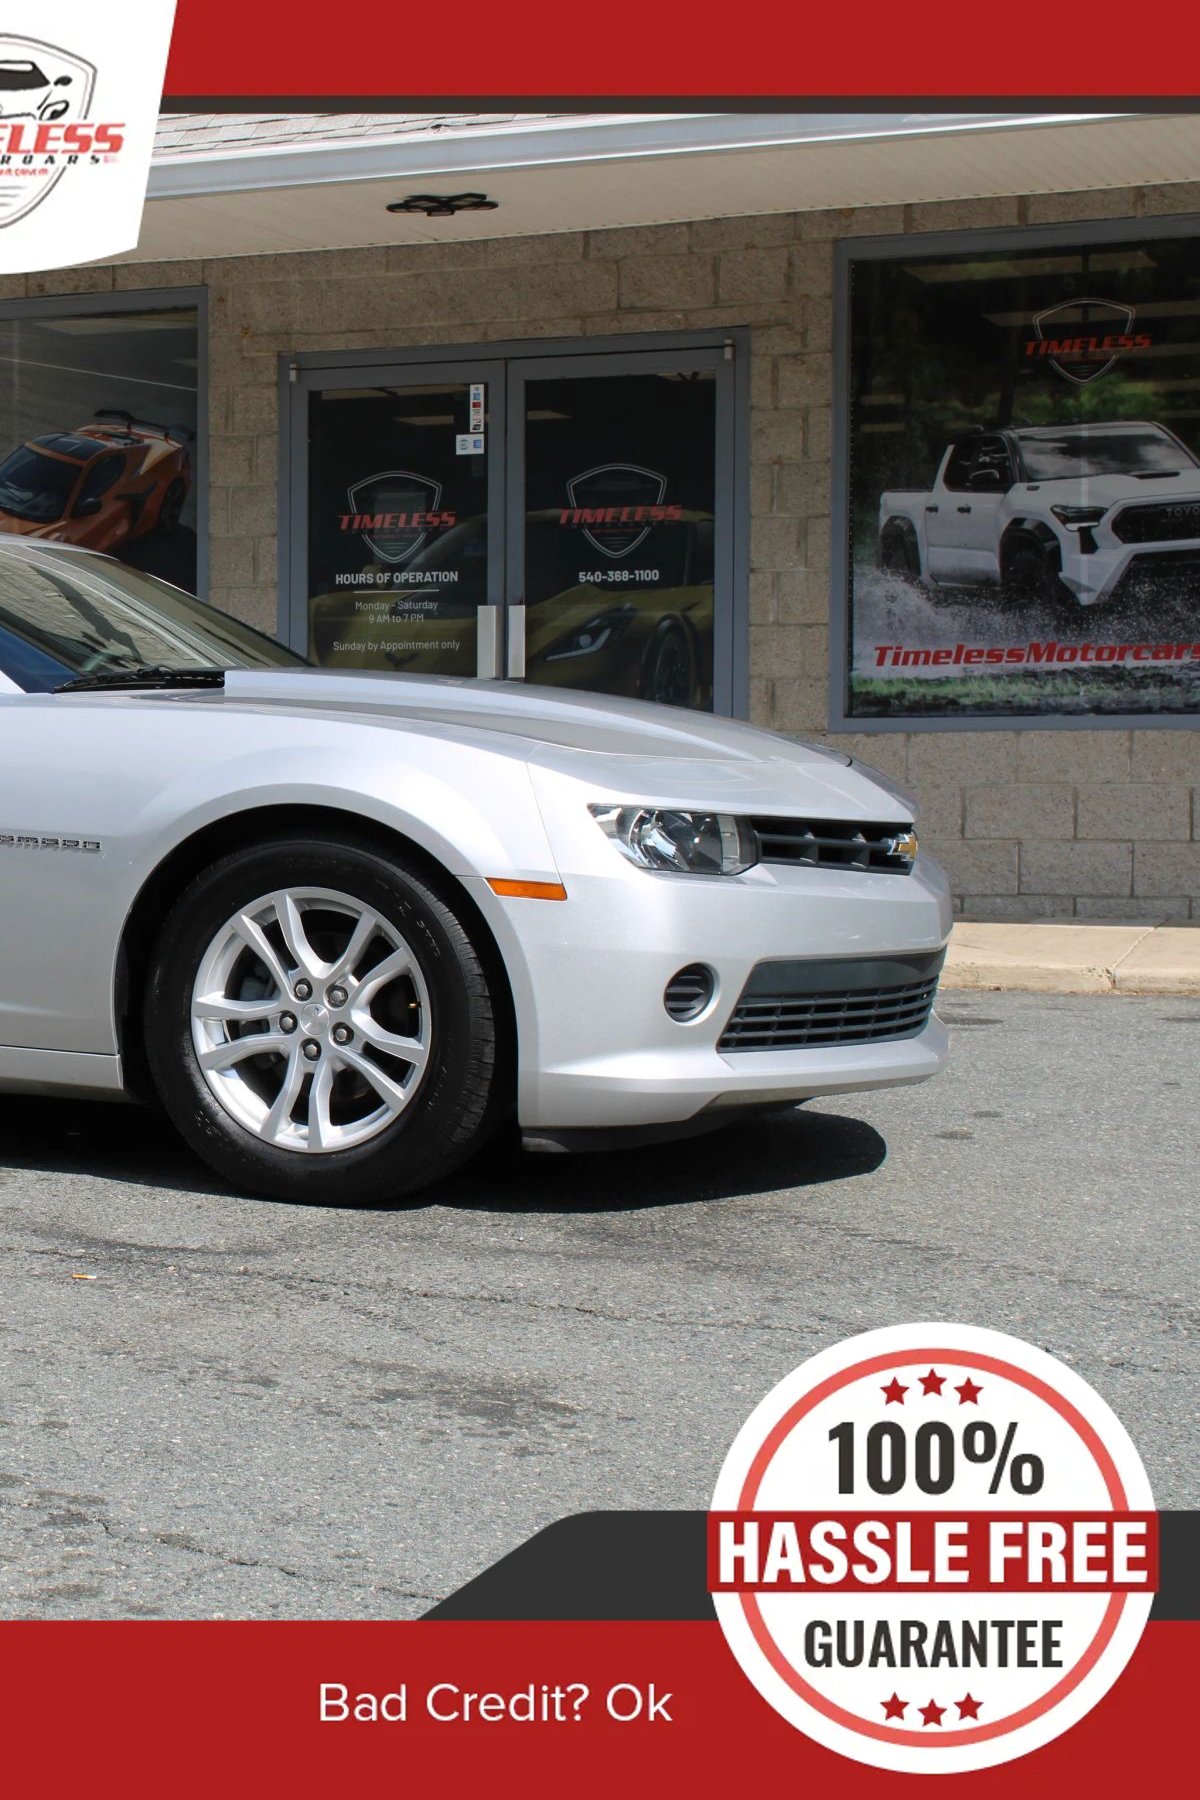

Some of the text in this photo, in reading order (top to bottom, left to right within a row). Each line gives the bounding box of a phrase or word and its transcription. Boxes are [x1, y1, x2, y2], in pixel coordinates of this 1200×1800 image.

[1025, 334, 1152, 356] TIMELESS
[337, 511, 456, 529] TIMELESS
[559, 504, 683, 524] TIMELESS
[335, 571, 459, 584] HOURS OF OPERATION
[578, 569, 659, 582] 540-368-1100
[355, 601, 389, 612] Monday
[398, 600, 438, 611] Saturday
[368, 613, 424, 623] 9 AM to 7 PM
[333, 640, 460, 652] Sunday by Appointment only
